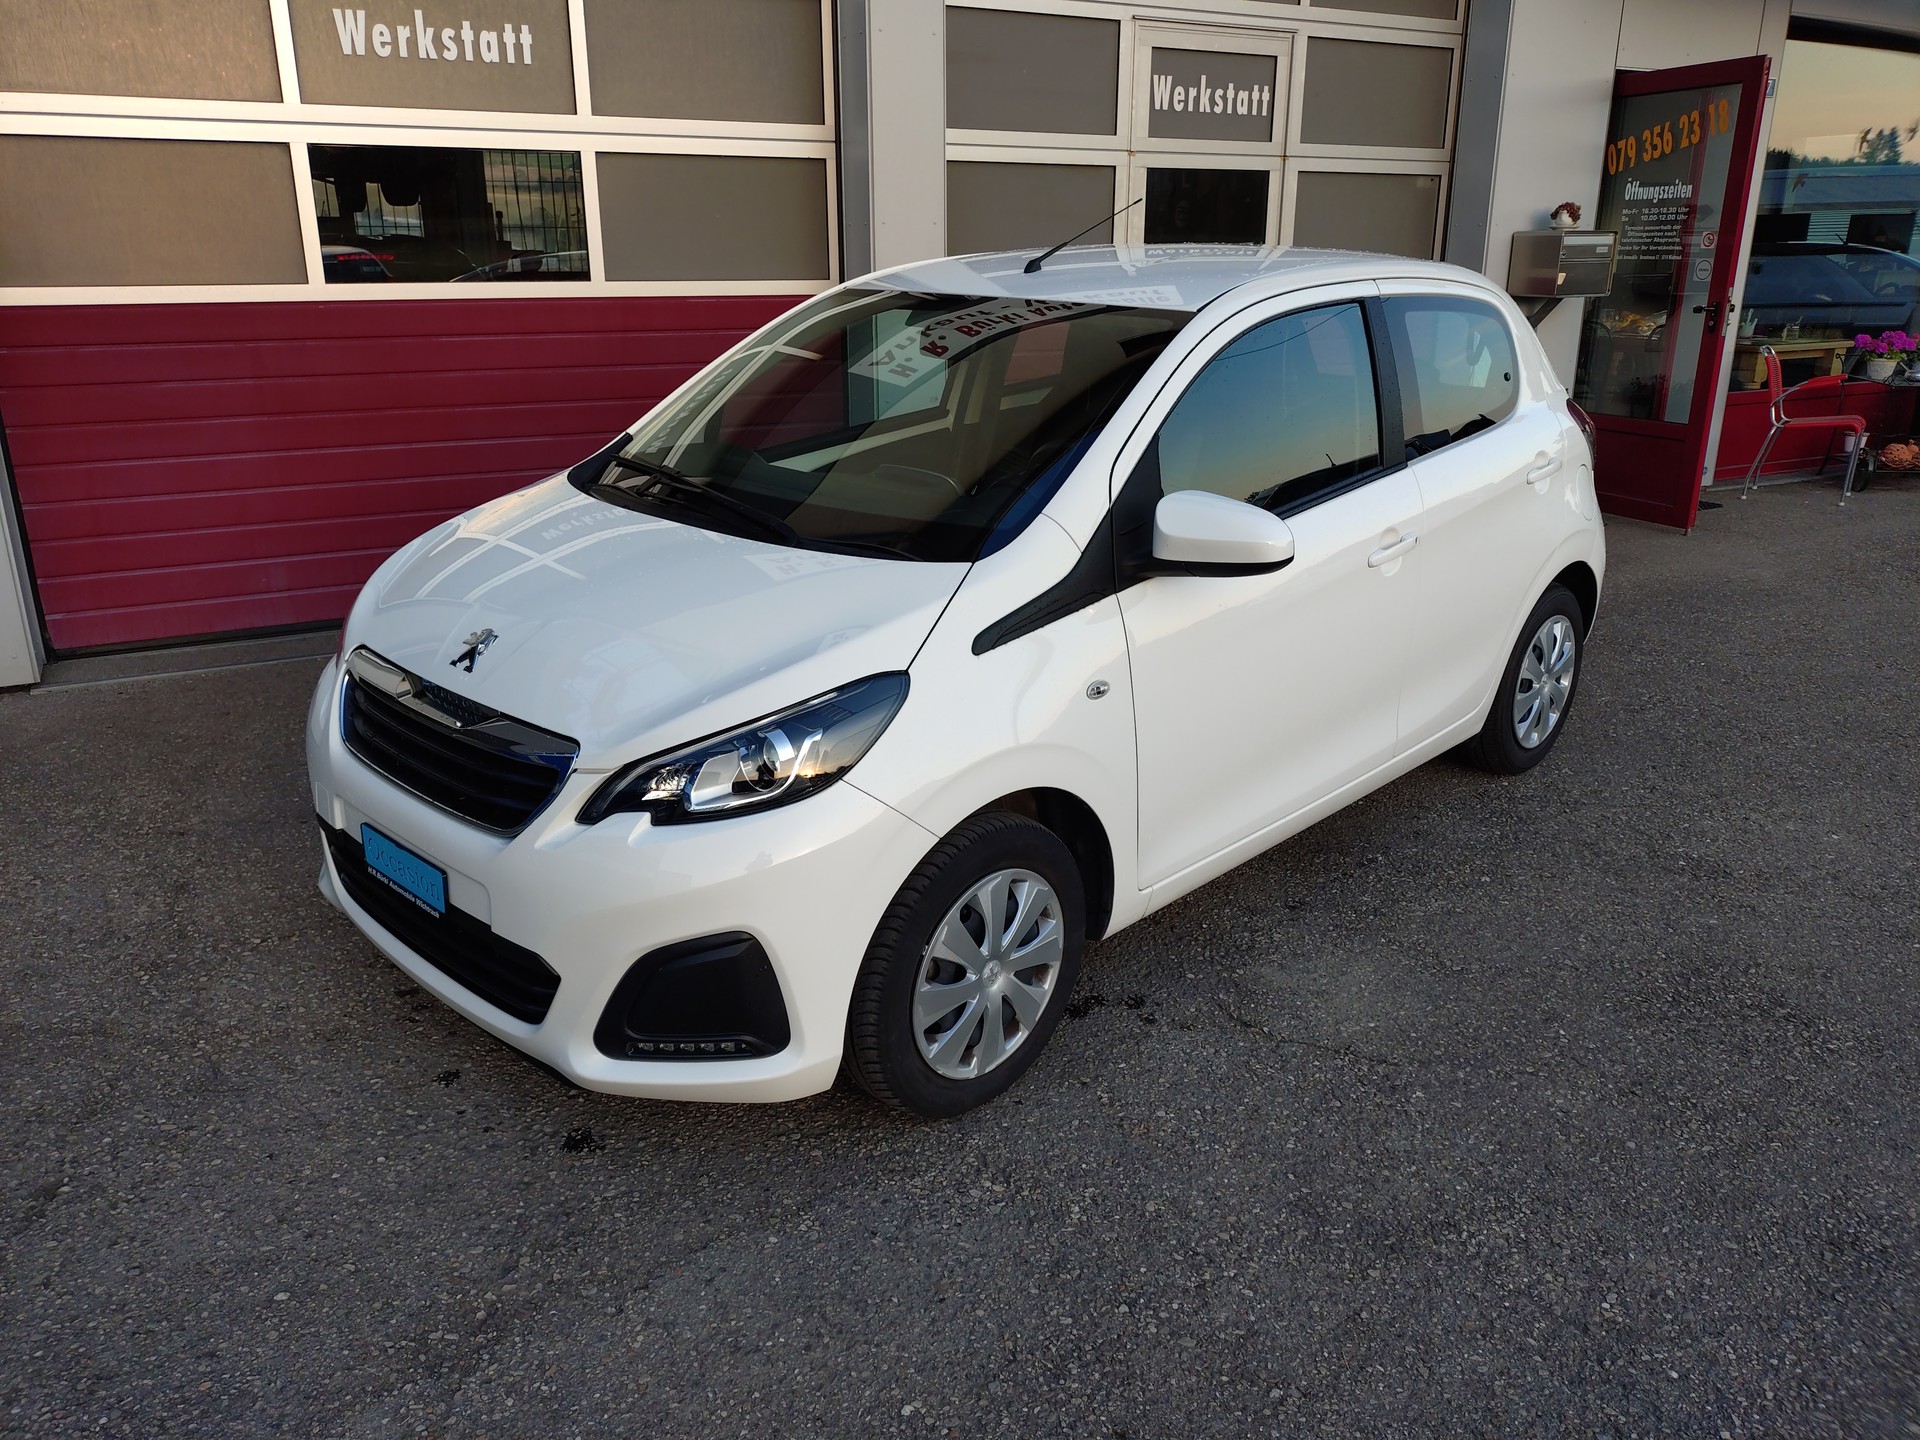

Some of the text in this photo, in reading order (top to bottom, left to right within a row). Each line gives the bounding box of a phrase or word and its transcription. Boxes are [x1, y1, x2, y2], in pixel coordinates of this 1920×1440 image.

[332, 8, 533, 65] Werkstatt
[1153, 74, 1270, 116] Werkstatt
[1607, 98, 1729, 176] 079 356 23 18
[1624, 177, 1693, 203] Öffnungszeiten
[368, 837, 441, 902] Occasion
[389, 880, 415, 903] Automobile
